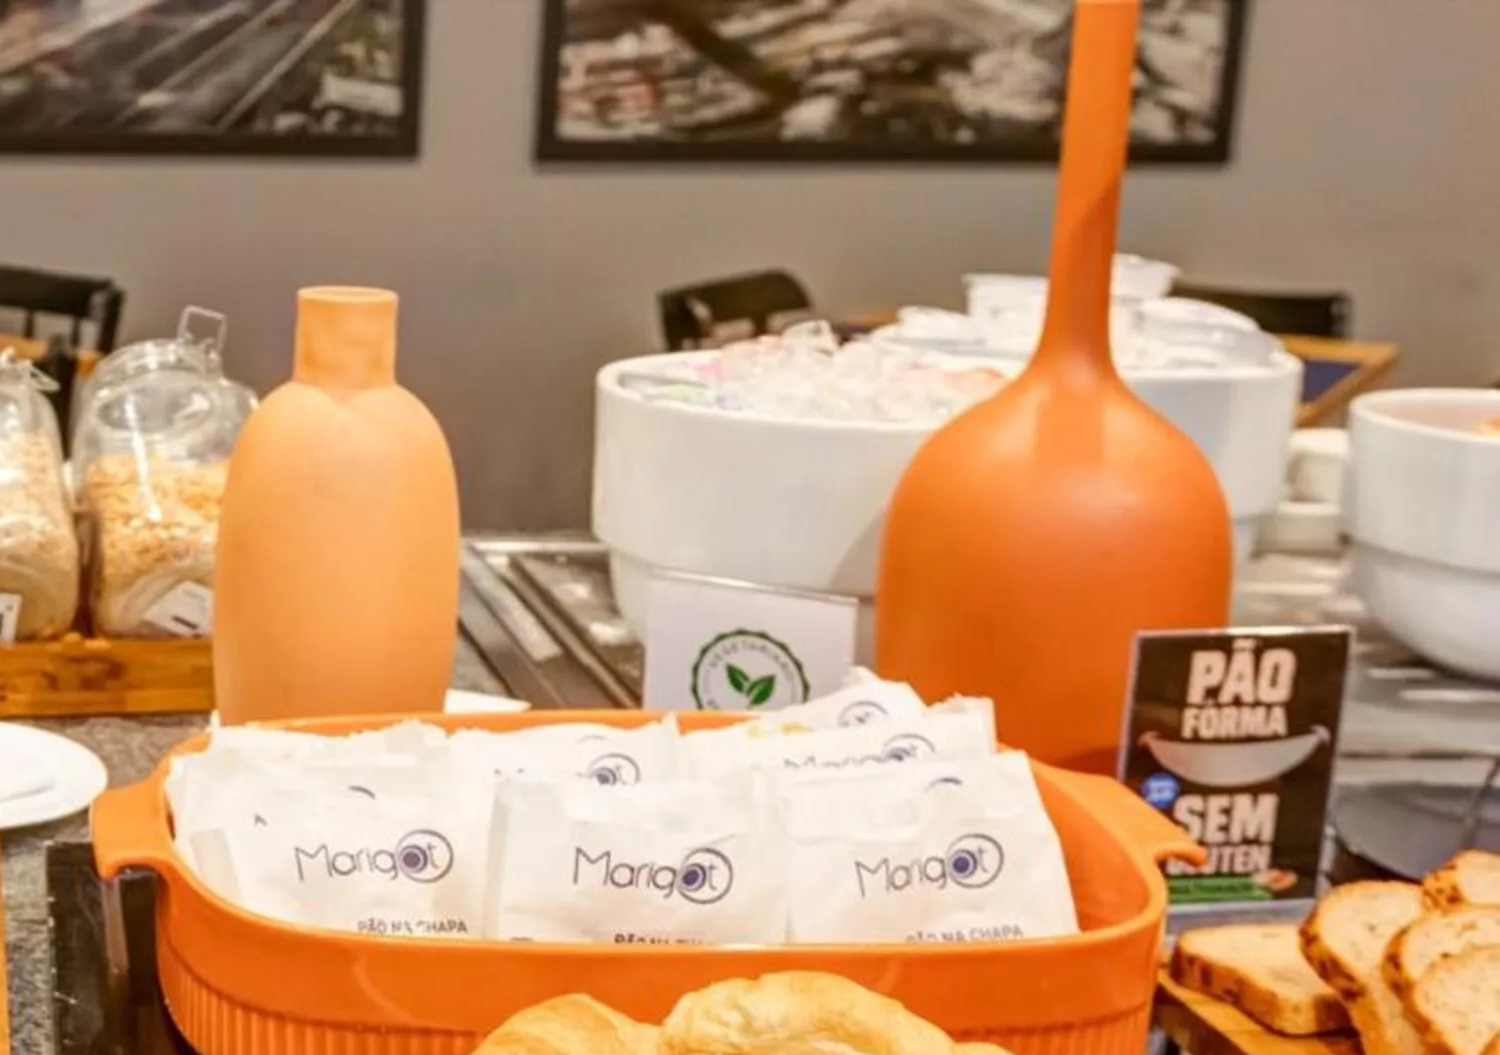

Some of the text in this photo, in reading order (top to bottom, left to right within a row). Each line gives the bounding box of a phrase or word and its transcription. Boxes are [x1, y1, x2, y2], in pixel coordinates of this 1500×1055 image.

[1186, 638, 1296, 705] PÃO
[1172, 793, 1280, 844] SEM
[293, 829, 454, 884] Marigot
[572, 847, 733, 905] Marigot
[855, 833, 1004, 898] Marigot
